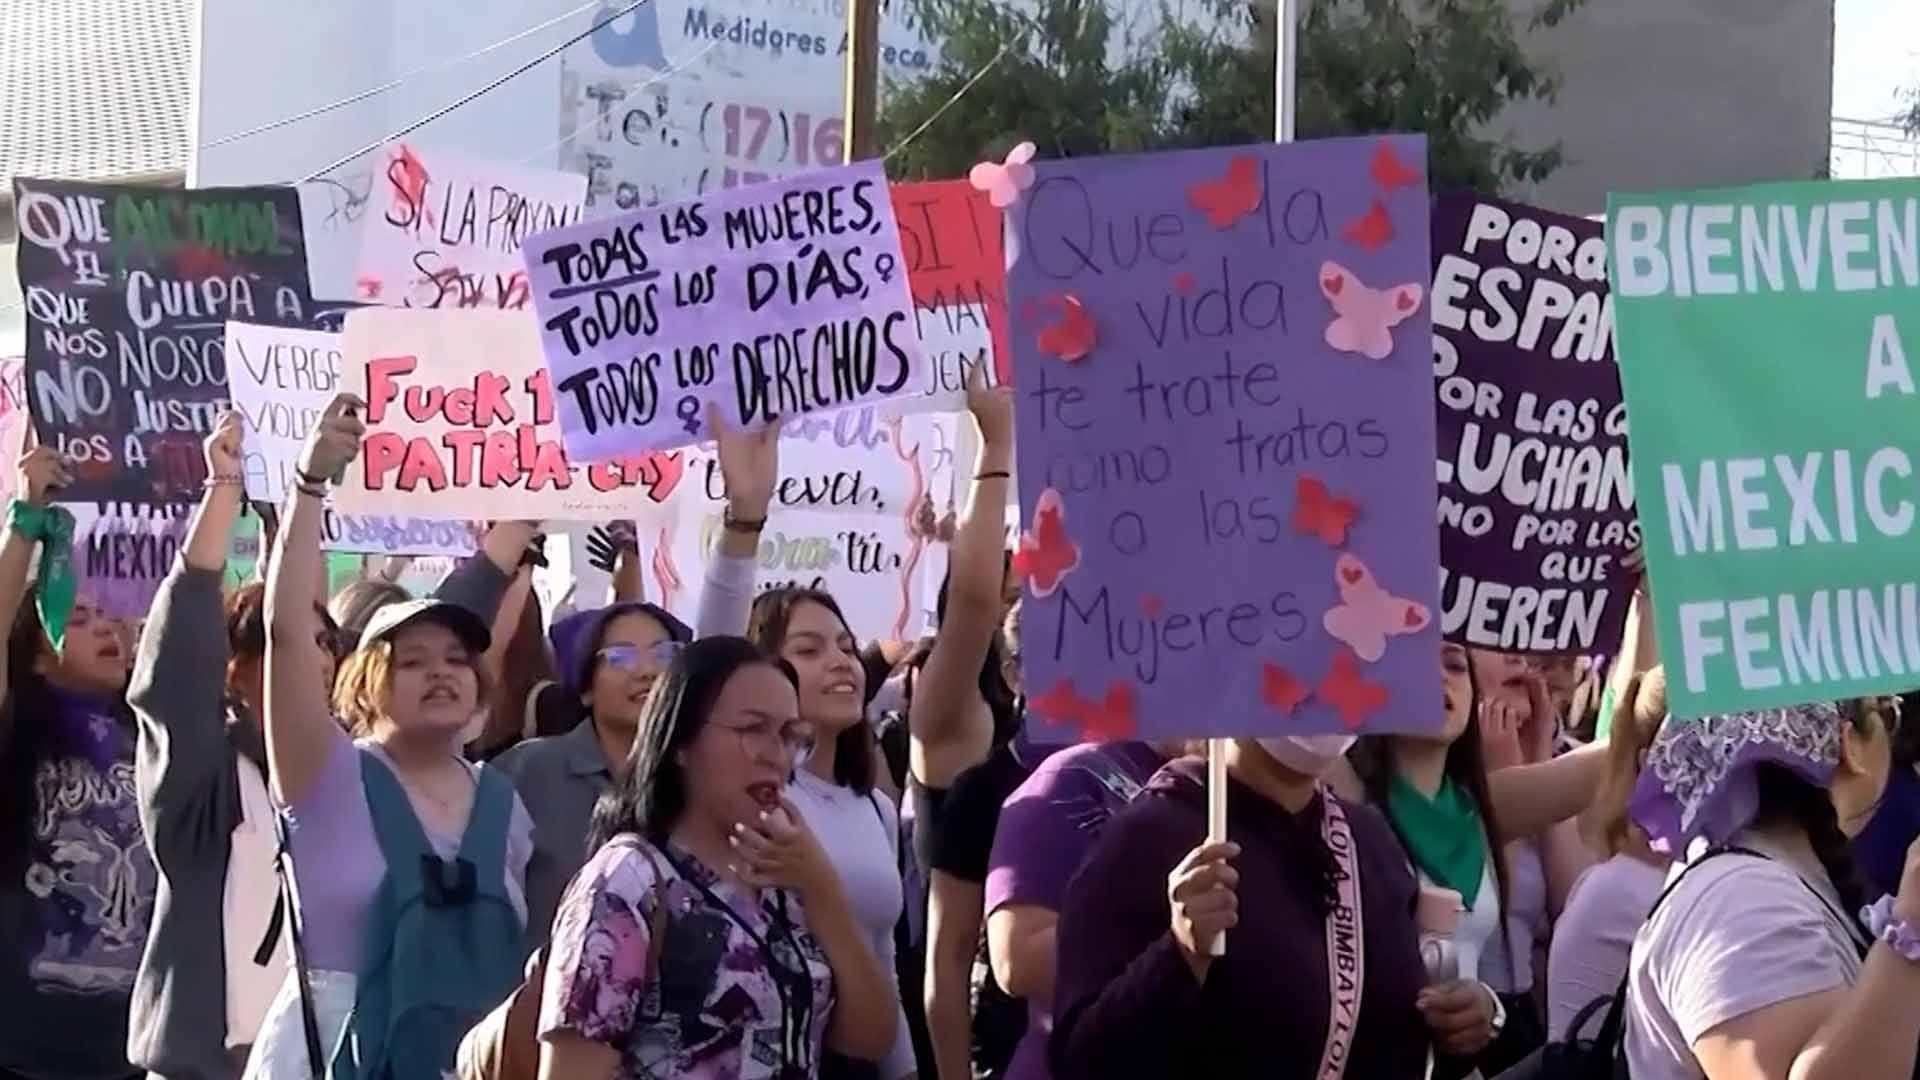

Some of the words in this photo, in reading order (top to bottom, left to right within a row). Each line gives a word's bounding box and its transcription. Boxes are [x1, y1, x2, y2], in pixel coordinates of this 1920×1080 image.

[683, 8, 826, 55] Medidores
[18, 186, 110, 265] QUE
[440, 180, 475, 246] LA
[542, 222, 650, 286] TODAS
[660, 202, 708, 245] LAS
[724, 180, 882, 250] MUJERES,
[1023, 174, 1190, 280] Que
[1260, 159, 1330, 250] la
[26, 286, 89, 327] QUE
[275, 287, 304, 320] A
[545, 282, 660, 357] TODOS
[674, 265, 718, 307] LOS
[746, 243, 870, 312] DÍAS,
[1134, 256, 1290, 350] vida
[44, 327, 108, 359] NOS
[557, 352, 661, 436] TODOS
[674, 343, 719, 389] LOS
[731, 311, 910, 426] DERECHOS
[1866, 314, 1915, 399] A
[35, 360, 111, 424] NO
[1029, 366, 1094, 432] te
[1124, 351, 1283, 422] trate
[1514, 390, 1600, 443] LAS
[124, 434, 147, 468] A
[1046, 443, 1172, 494] como
[1224, 407, 1390, 475] tratas
[1436, 422, 1635, 512] UCHAN
[1108, 509, 1148, 557] a
[1199, 488, 1282, 546] las
[1437, 496, 1495, 538] NO
[1511, 513, 1579, 551] POR
[1584, 518, 1641, 550] LAS
[1662, 445, 1915, 556] MEXIC
[1540, 551, 1612, 583] QUE
[1053, 584, 1308, 686] Mujeres
